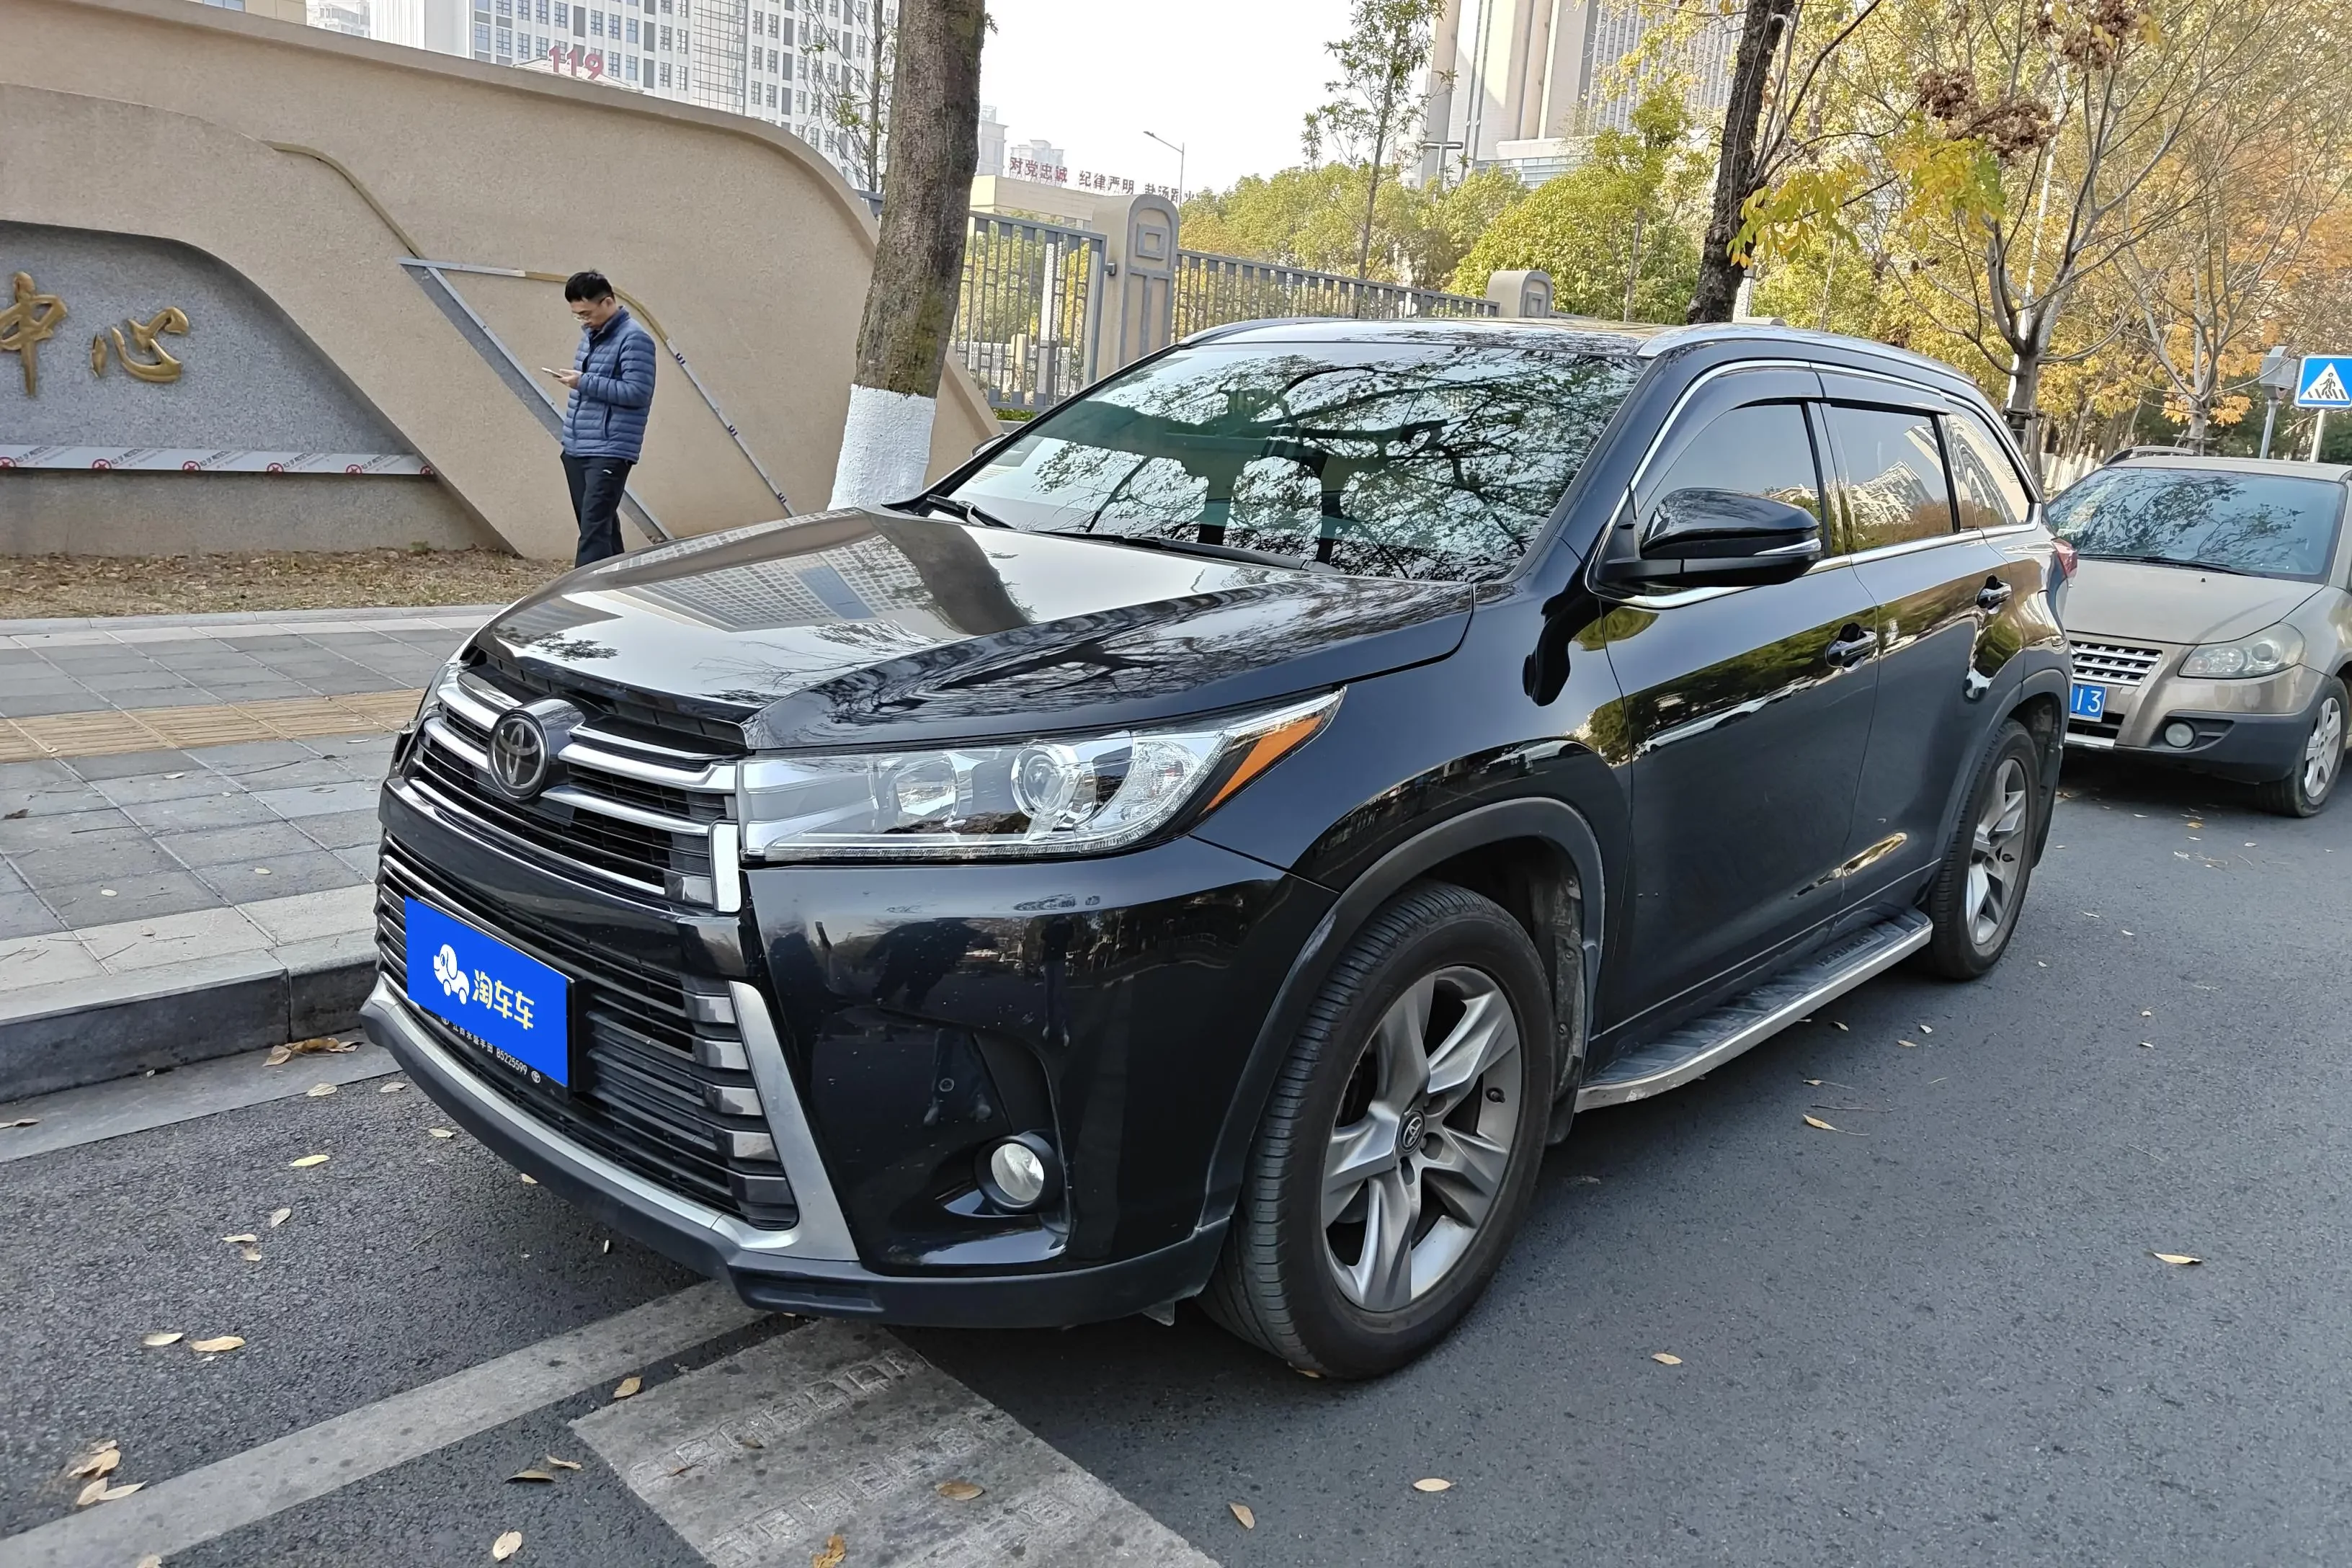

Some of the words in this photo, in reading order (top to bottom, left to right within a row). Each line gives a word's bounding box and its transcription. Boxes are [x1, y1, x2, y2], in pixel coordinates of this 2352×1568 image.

[548, 45, 604, 80] 119
[1010, 156, 1068, 183] 对党忠诚
[1079, 169, 1135, 195] 纪律严明
[0, 271, 189, 398] 中心
[496, 1048, 527, 1075] 85225599
